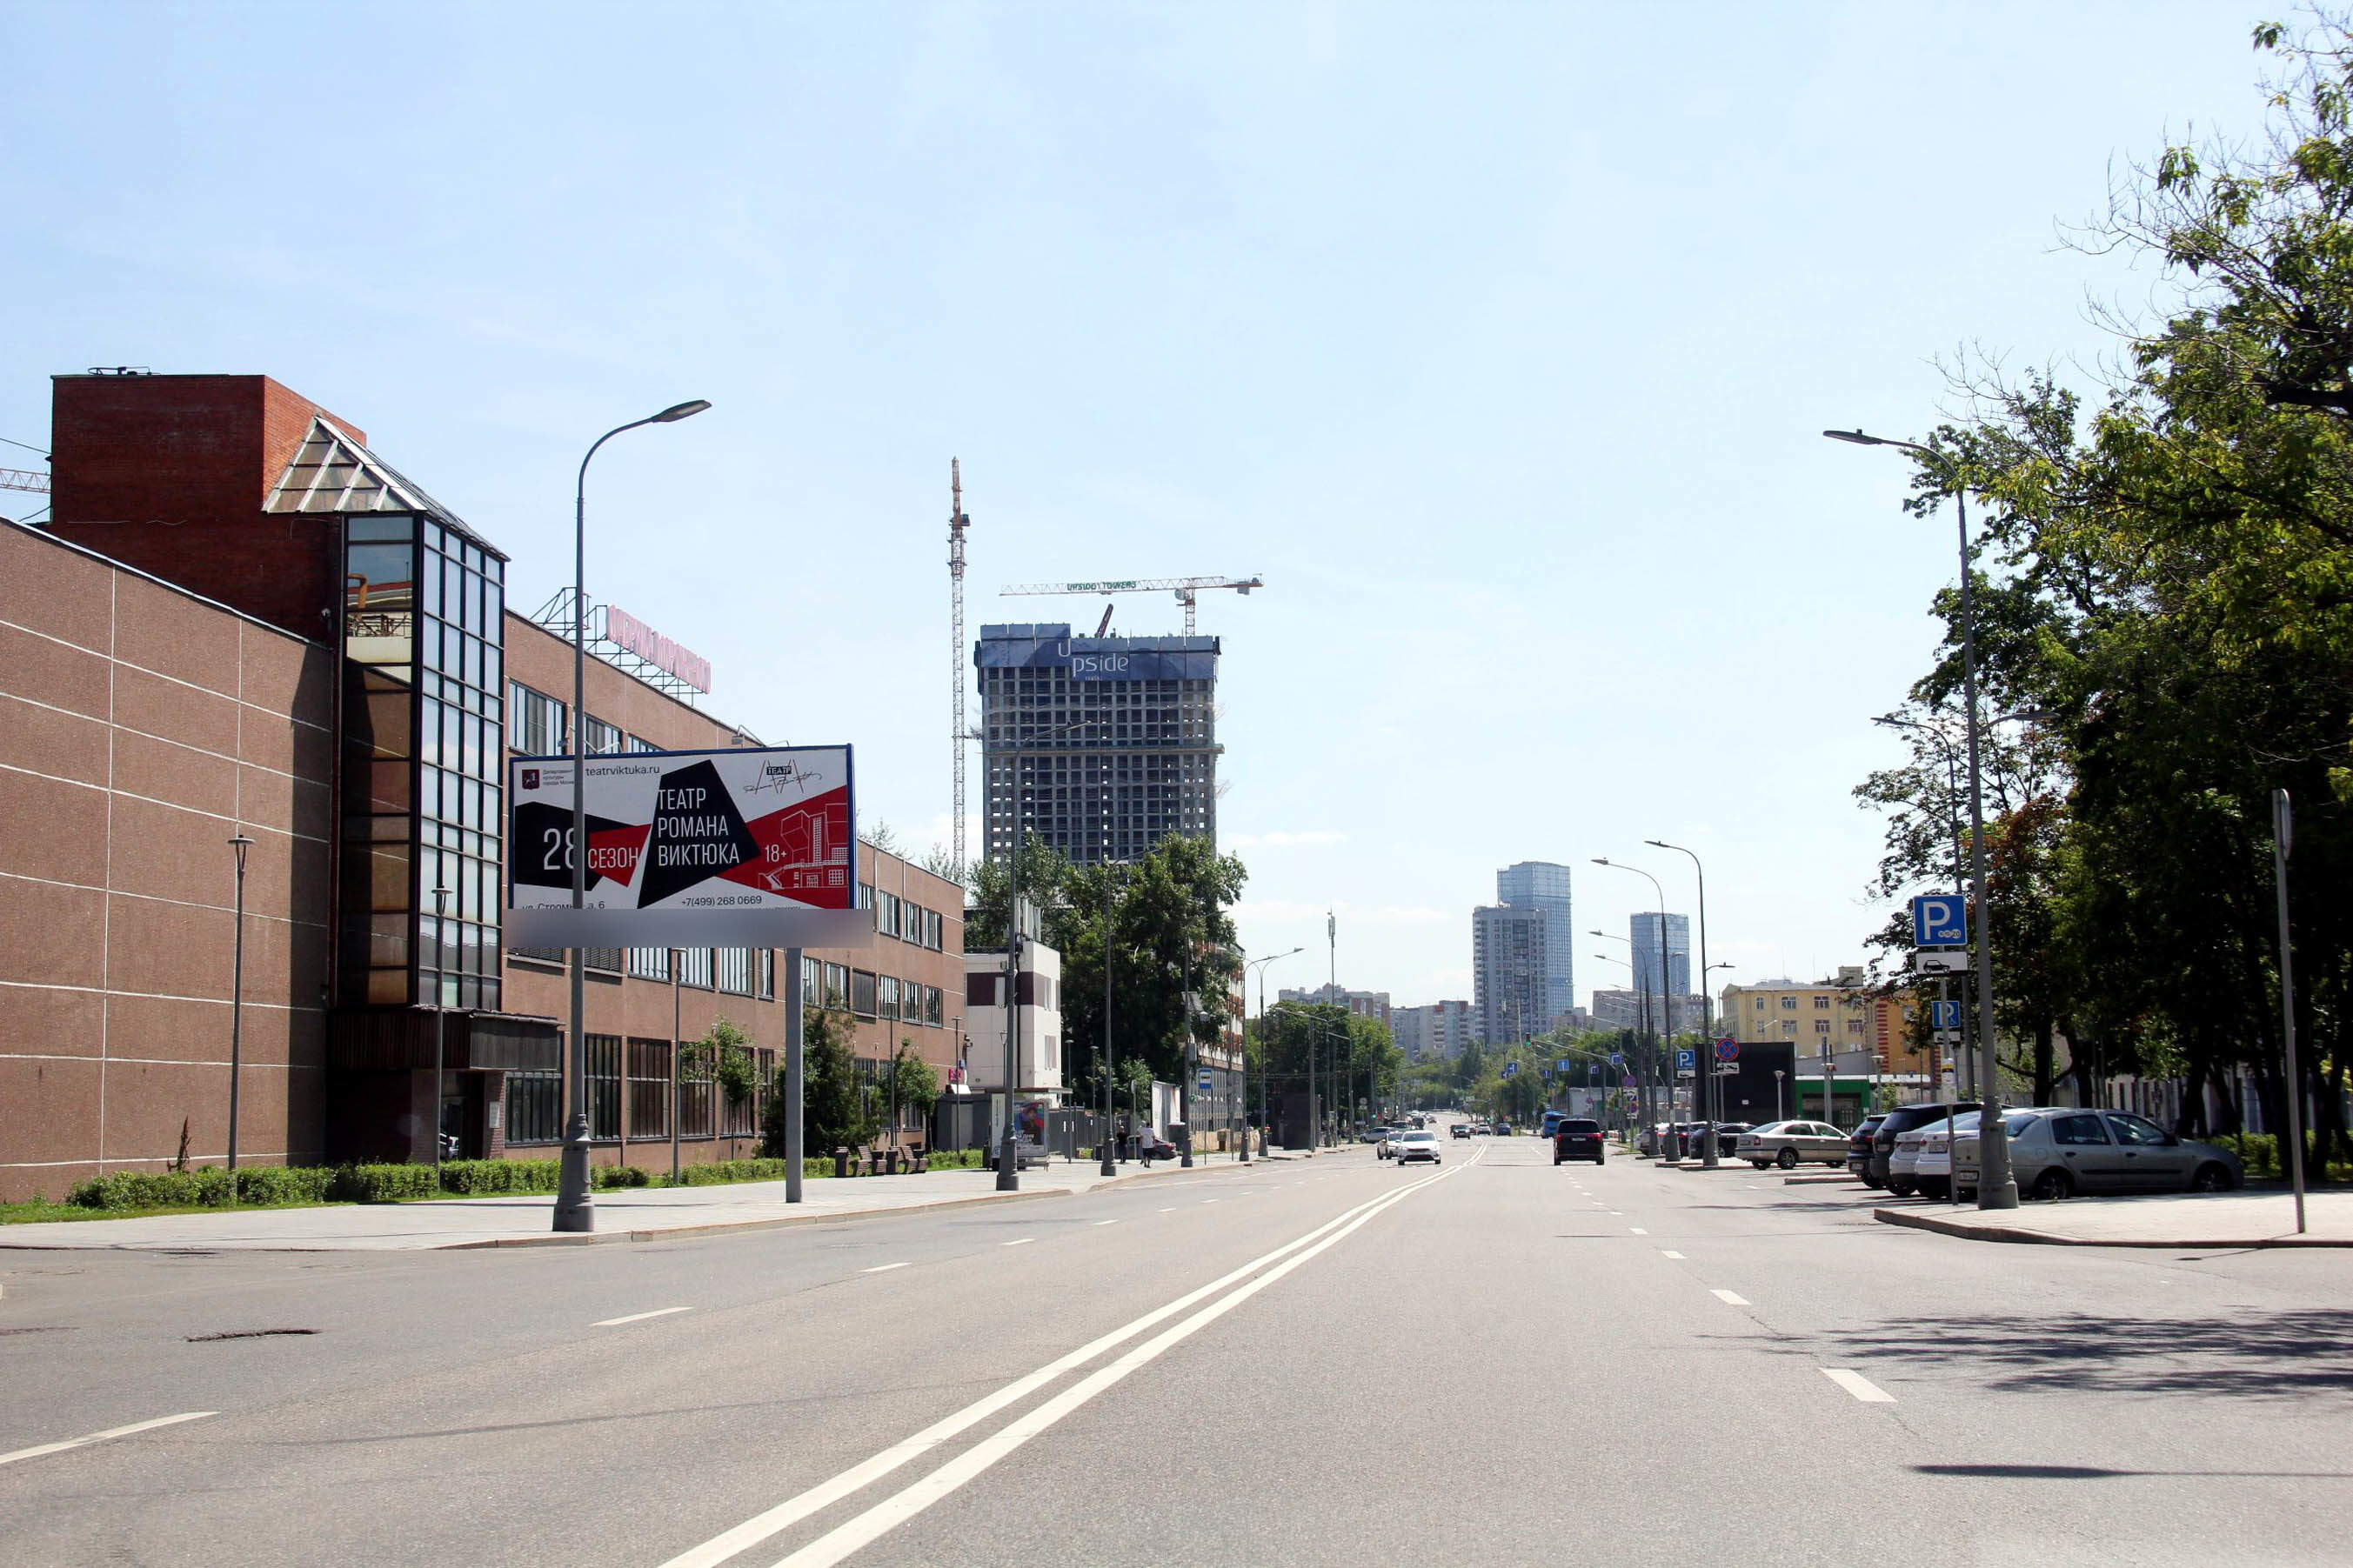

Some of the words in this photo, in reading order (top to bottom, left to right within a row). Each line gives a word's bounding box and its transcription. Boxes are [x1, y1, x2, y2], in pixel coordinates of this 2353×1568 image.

[585, 765, 660, 777] teatrviktuka.ru
[658, 788, 706, 811] ТЕАТР
[658, 815, 729, 838] РОМАНА
[587, 846, 638, 870] СЕЗОН
[658, 843, 740, 866] ВИКТЮКА
[765, 844, 787, 863] 18+
[681, 896, 715, 908] +7(499)
[717, 897, 736, 905] 268
[737, 895, 763, 905] 0669
[1923, 901, 1951, 940] P
[1679, 1052, 1690, 1067] P
